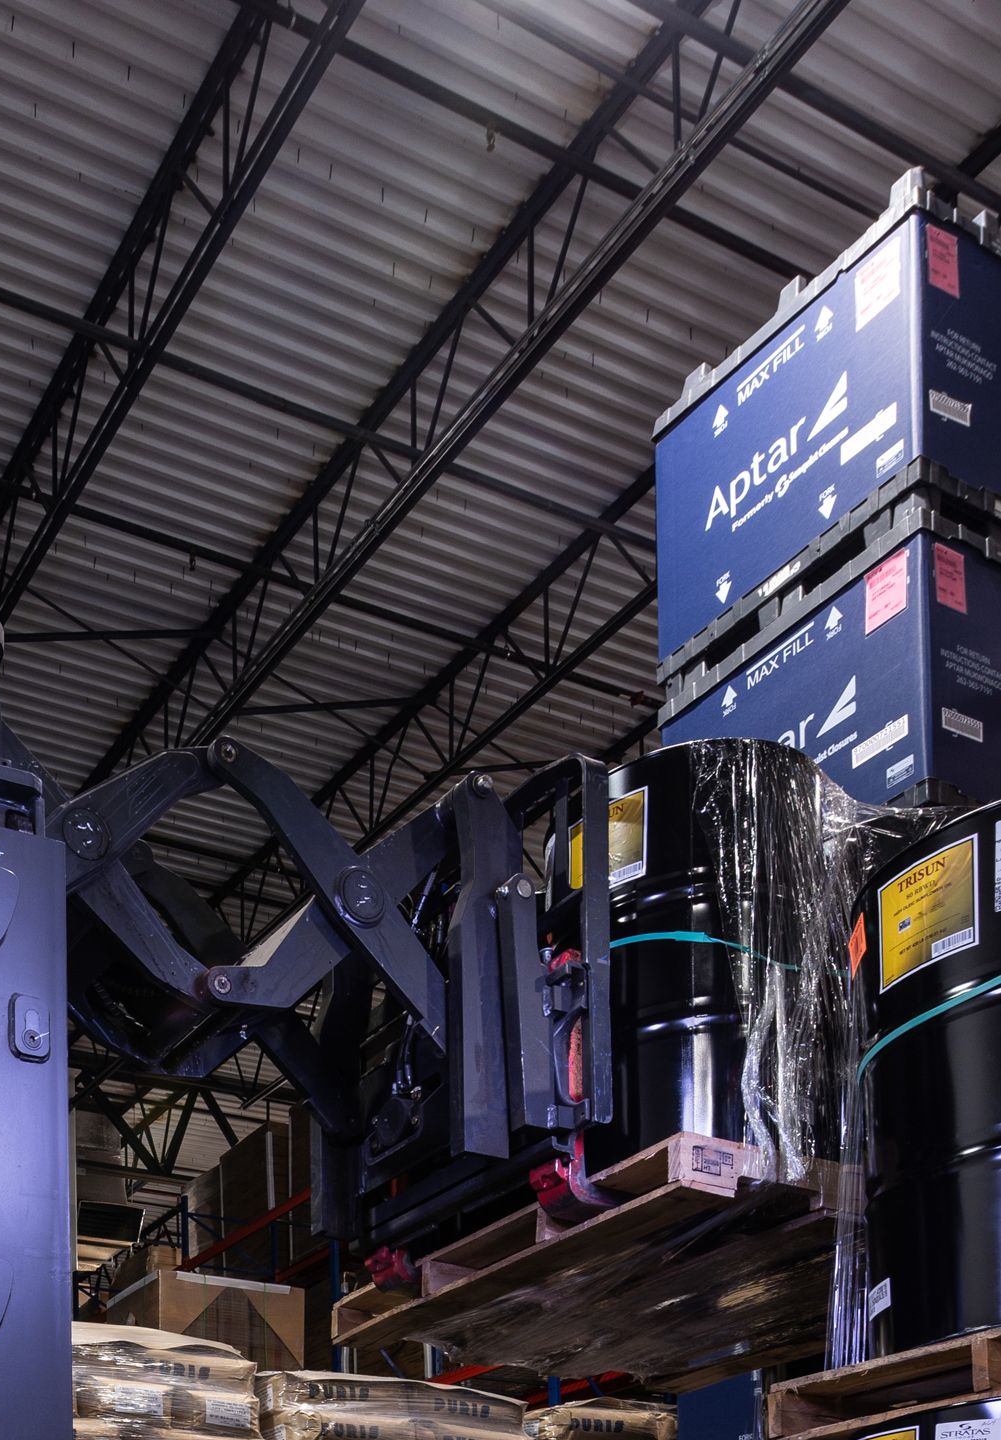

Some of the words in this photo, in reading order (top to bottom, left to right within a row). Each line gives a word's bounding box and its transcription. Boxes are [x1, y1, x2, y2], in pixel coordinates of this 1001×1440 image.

[737, 364, 770, 406] MAX
[772, 337, 805, 373] FILL
[704, 415, 807, 532] Aptar
[731, 491, 774, 533] Formerly
[715, 570, 731, 587] FORK
[746, 655, 780, 690] MAX
[783, 631, 815, 663] FILL
[897, 856, 946, 893] TRISUN
[308, 1383, 370, 1400] PURIS
[435, 1397, 491, 1418] PURIS
[570, 1418, 625, 1434] PURIS
[940, 1429, 991, 1439] STRATAS
